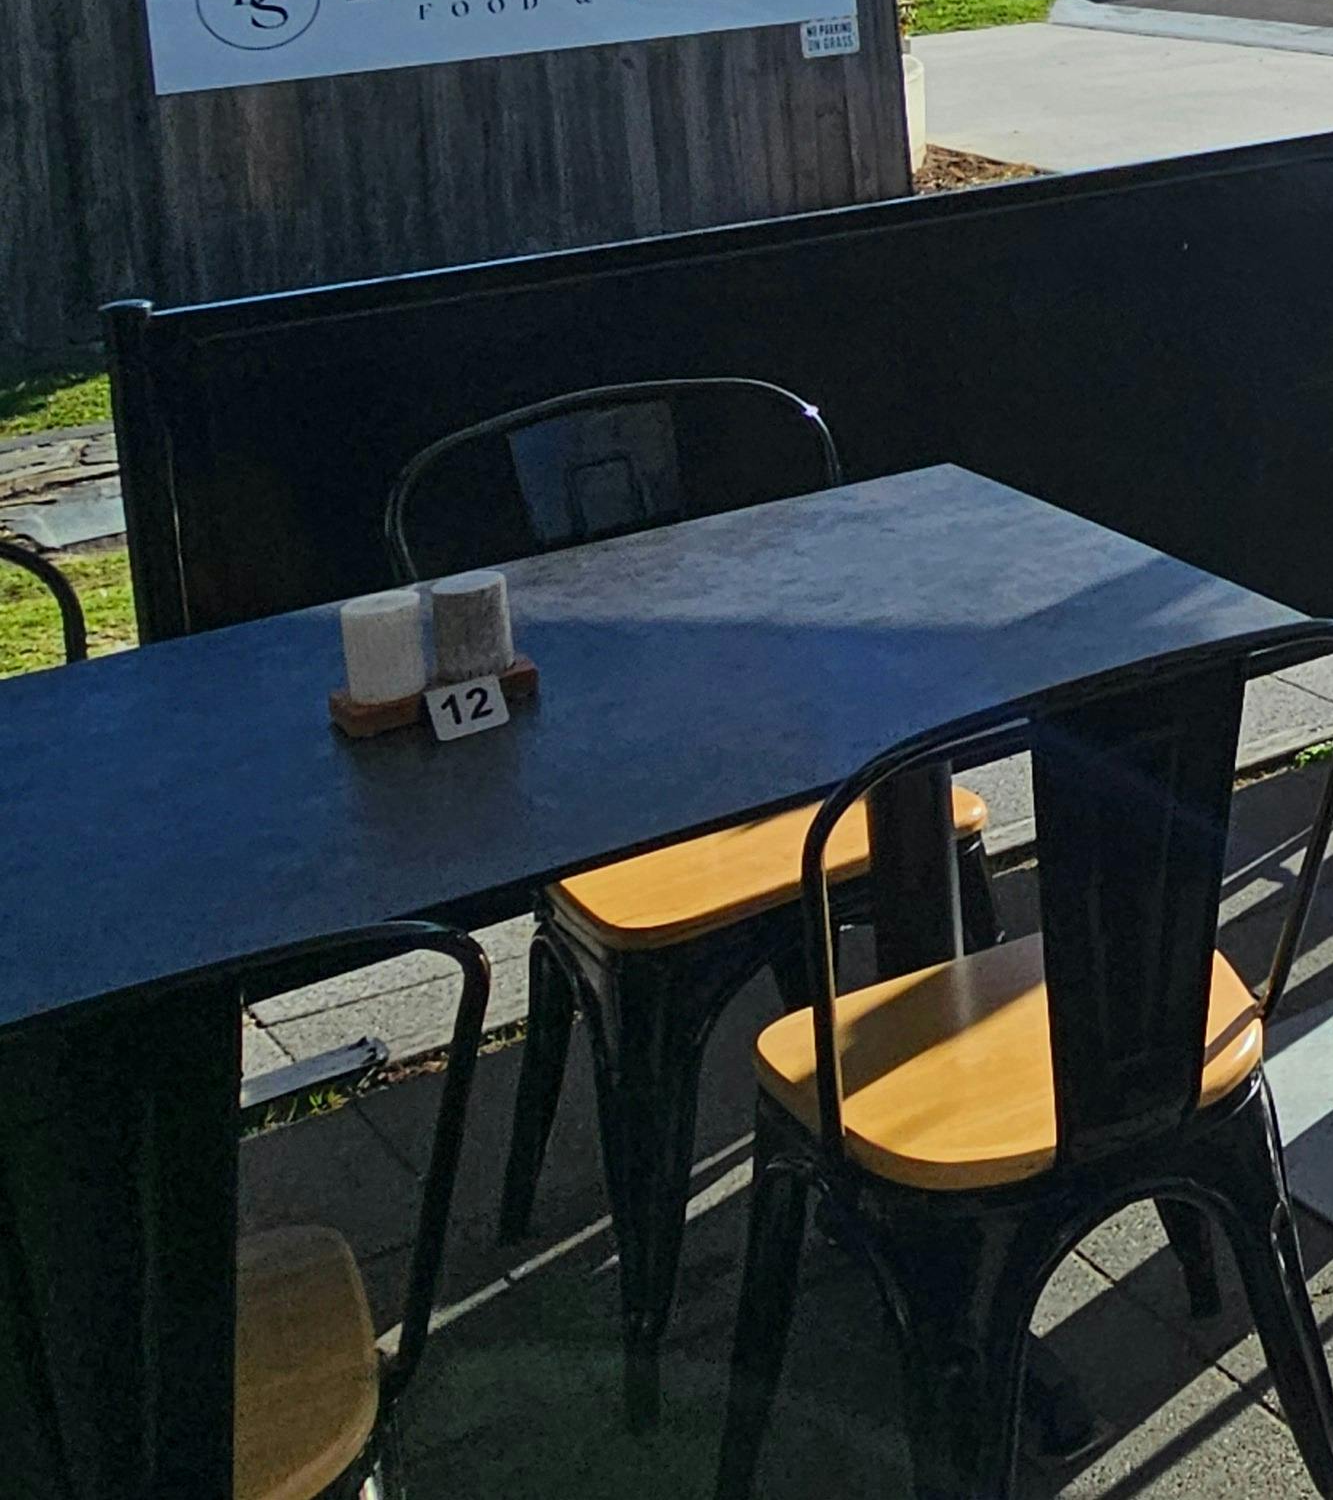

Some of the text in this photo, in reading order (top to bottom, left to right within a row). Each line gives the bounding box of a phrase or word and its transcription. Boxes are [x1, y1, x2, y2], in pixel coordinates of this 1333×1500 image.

[807, 21, 852, 37] NO PARKING
[808, 35, 853, 52] ON GRASS
[441, 687, 493, 725] 12
